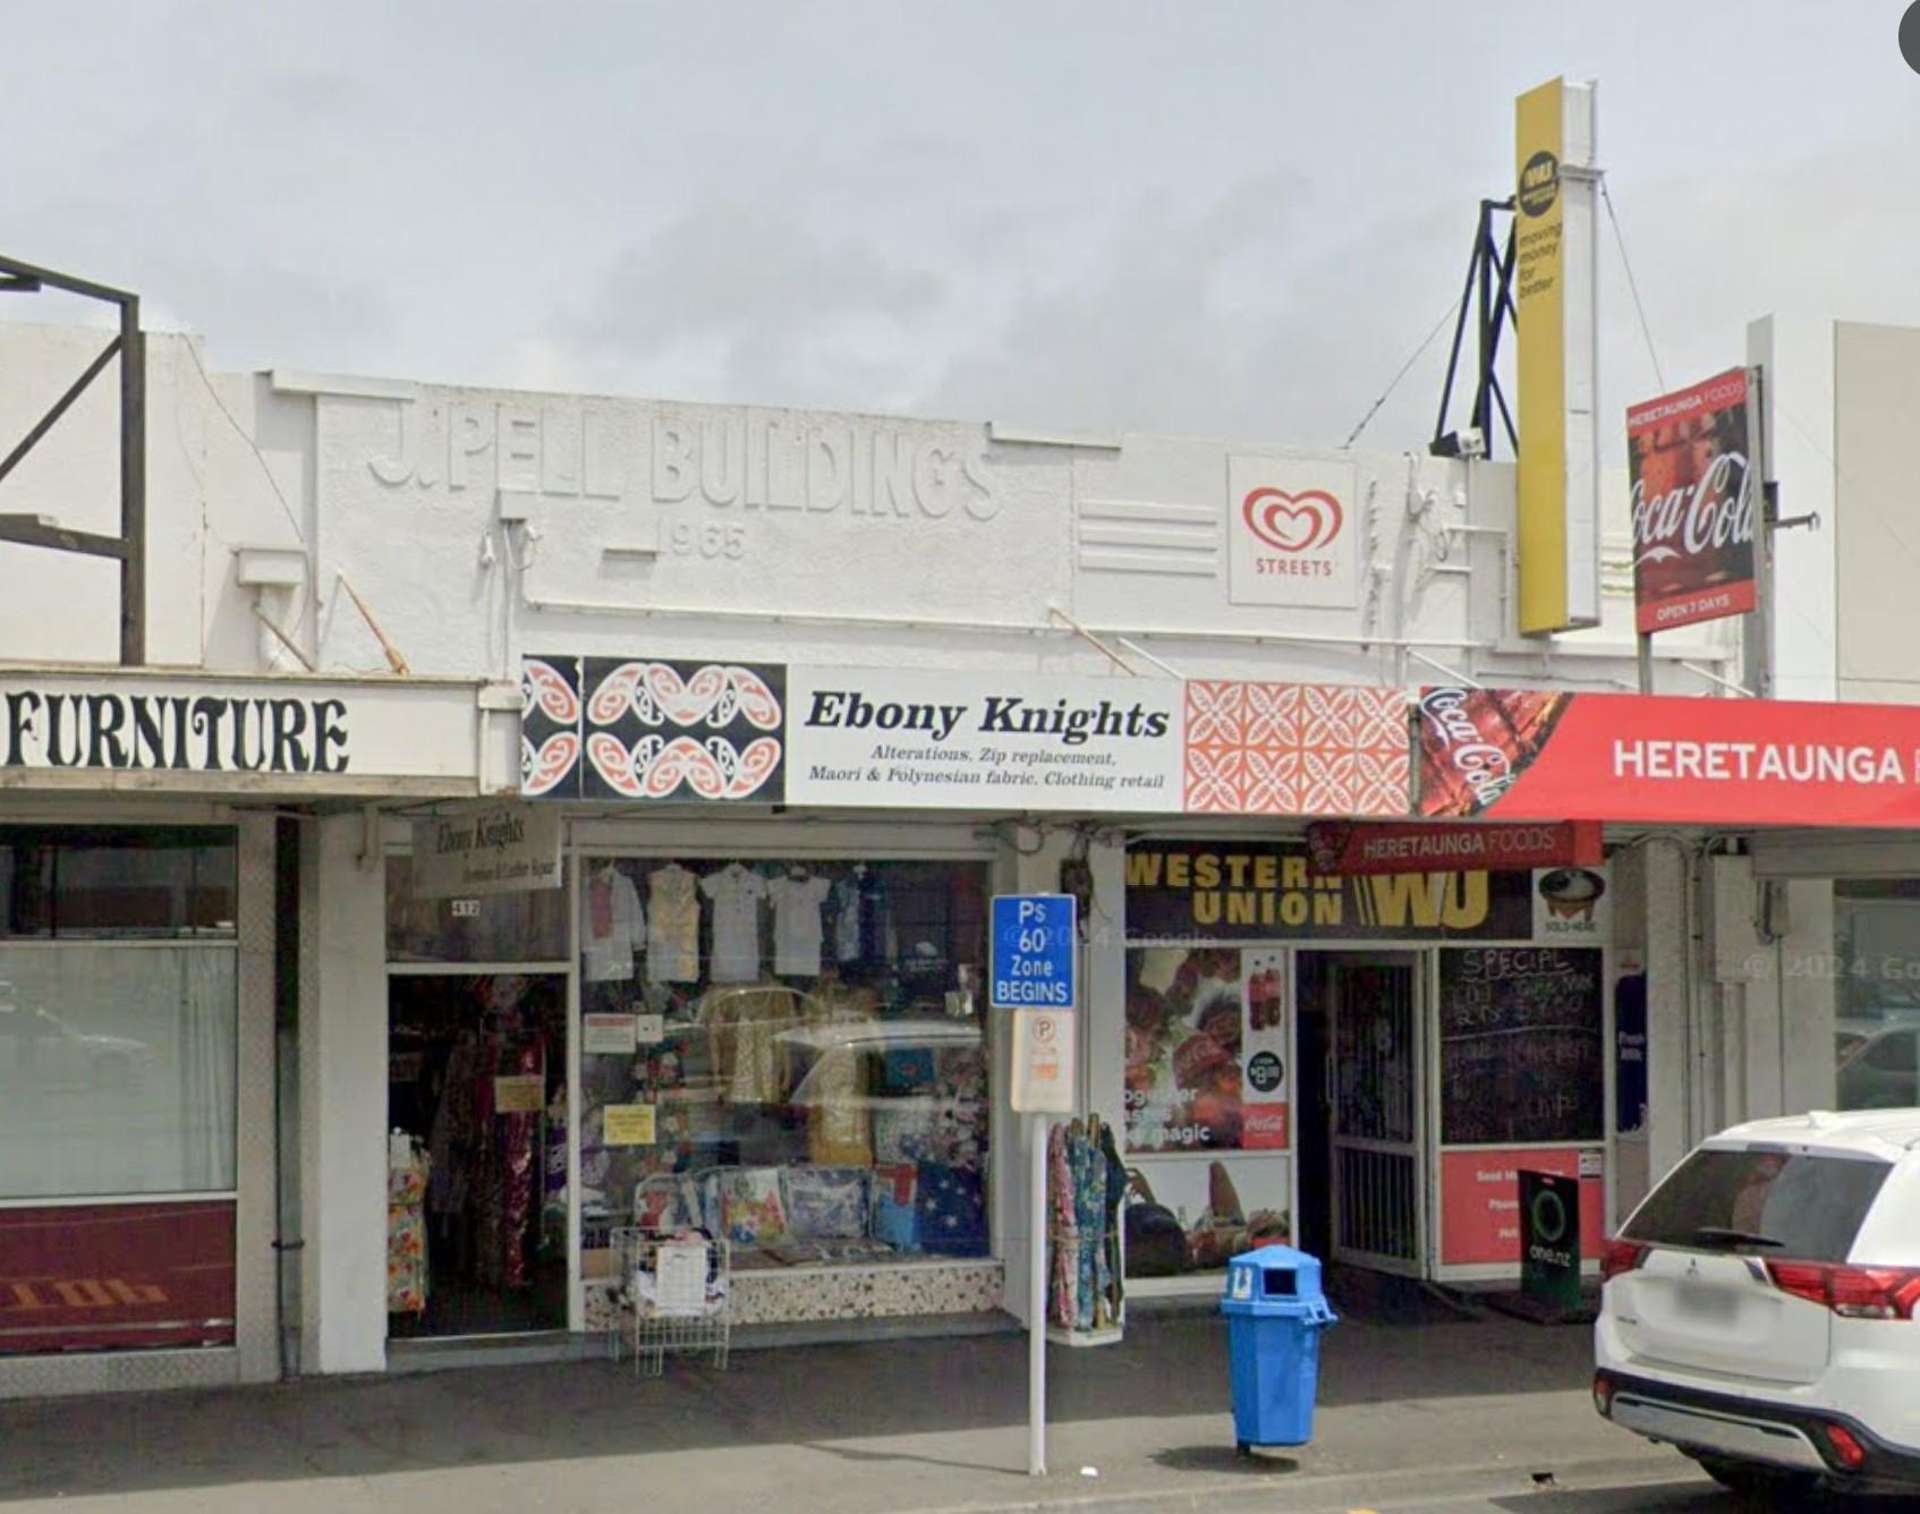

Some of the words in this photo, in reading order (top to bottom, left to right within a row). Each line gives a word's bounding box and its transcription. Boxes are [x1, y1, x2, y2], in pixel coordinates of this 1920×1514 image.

[1519, 242, 1558, 264] money
[1519, 266, 1535, 282] for
[1519, 275, 1555, 298] better
[1629, 393, 1702, 428] HERETAUNGA
[1703, 381, 1745, 405] FOODS
[650, 408, 1002, 522] BUILDINGS
[1256, 558, 1332, 576] STREETS
[1656, 602, 1688, 622] OPEN
[1699, 594, 1730, 613] DAYS
[805, 690, 968, 741] Ebony
[978, 697, 1170, 745] Knights
[3, 690, 350, 774] FURNITURE
[979, 747, 1007, 766] Zip
[1613, 739, 1905, 784] HERETAUNGA
[809, 765, 861, 782] Maori
[866, 768, 880, 782] &
[887, 768, 981, 788] Polynesian
[1044, 771, 1115, 790] Clothing
[1119, 773, 1165, 790] retail
[1362, 833, 1485, 860] HERETAUNGA
[1488, 828, 1556, 852] FOODS
[1193, 890, 1343, 926] UNION
[1018, 928, 1047, 952] 60
[1010, 955, 1053, 977] Zone
[996, 980, 1069, 1002] BEGINS
